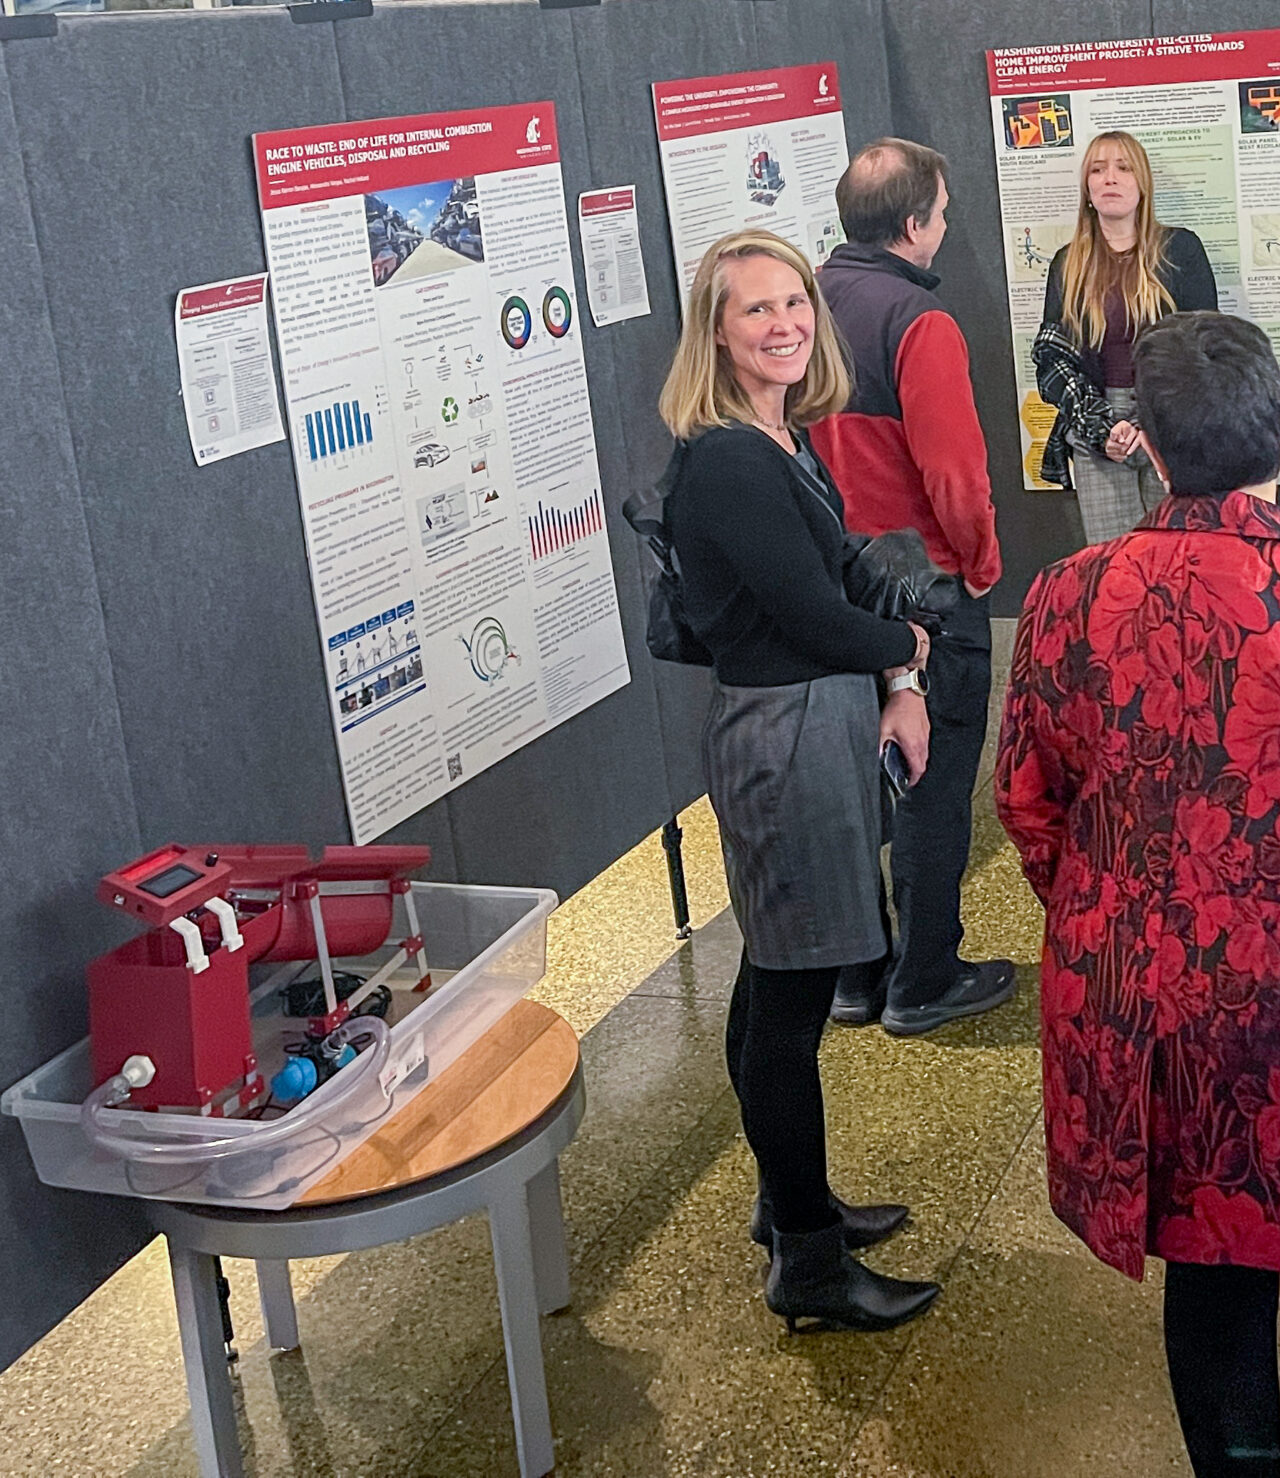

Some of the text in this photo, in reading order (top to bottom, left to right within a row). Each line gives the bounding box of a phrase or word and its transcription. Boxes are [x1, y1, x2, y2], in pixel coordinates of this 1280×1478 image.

[994, 34, 1212, 57] WASHINGTON STATE UNIVERSITY TRI-CITIES
[995, 41, 1245, 67] HOME IMPROVEMENT PROJECT: A STRIVE TOWARDS
[996, 64, 1067, 77] CLEAN ENERGY
[266, 122, 492, 160] RACE TO WASTE: END OF LIFE FOR INTERNAL COMBUSTION
[268, 141, 450, 176] ENGINE VEHICLES, DISPOSAL AND RECYCLING
